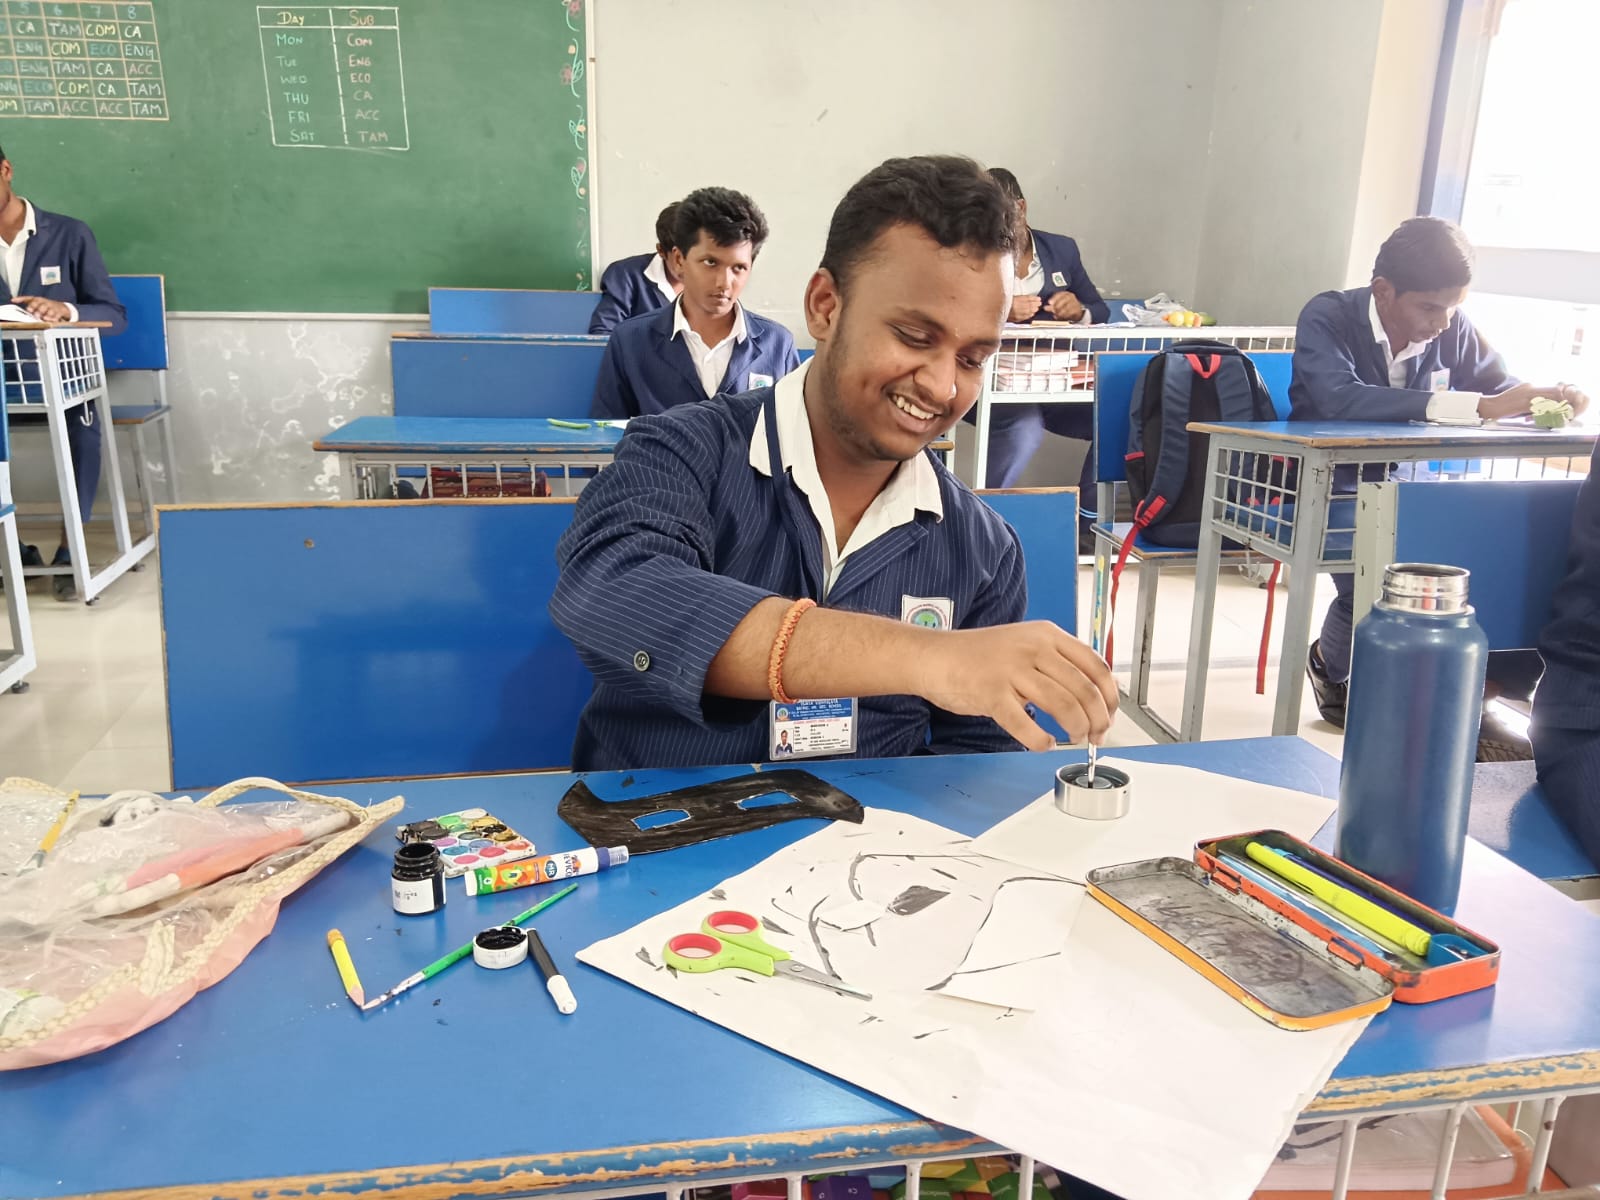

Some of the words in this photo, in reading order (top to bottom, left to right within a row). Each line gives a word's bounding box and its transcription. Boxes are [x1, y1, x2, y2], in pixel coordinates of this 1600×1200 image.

[19, 2, 29, 14] 5
[53, 6, 62, 16] 6
[90, 5, 101, 17] 7
[127, 6, 137, 19] 8
[16, 21, 35, 34] CA
[48, 22, 82, 36] TAM
[86, 23, 116, 37] COM
[124, 25, 142, 39] CA
[51, 42, 80, 56] COM
[89, 44, 117, 56] ECO
[55, 62, 86, 75] TAM
[95, 62, 114, 76] CA
[129, 63, 153, 75] ACC
[350, 73, 371, 84] ECO
[24, 80, 52, 93] ECO
[58, 81, 90, 95] COM
[98, 82, 116, 96] CA
[129, 82, 161, 96] TAM
[283, 92, 309, 105] THU
[353, 90, 373, 101] CA
[25, 100, 55, 113] TAM
[61, 101, 89, 113] ACC
[99, 102, 124, 114] ACC
[132, 102, 162, 115] TAM
[288, 111, 310, 123] FRI
[355, 109, 380, 121] ACC
[357, 131, 388, 143] TAM
